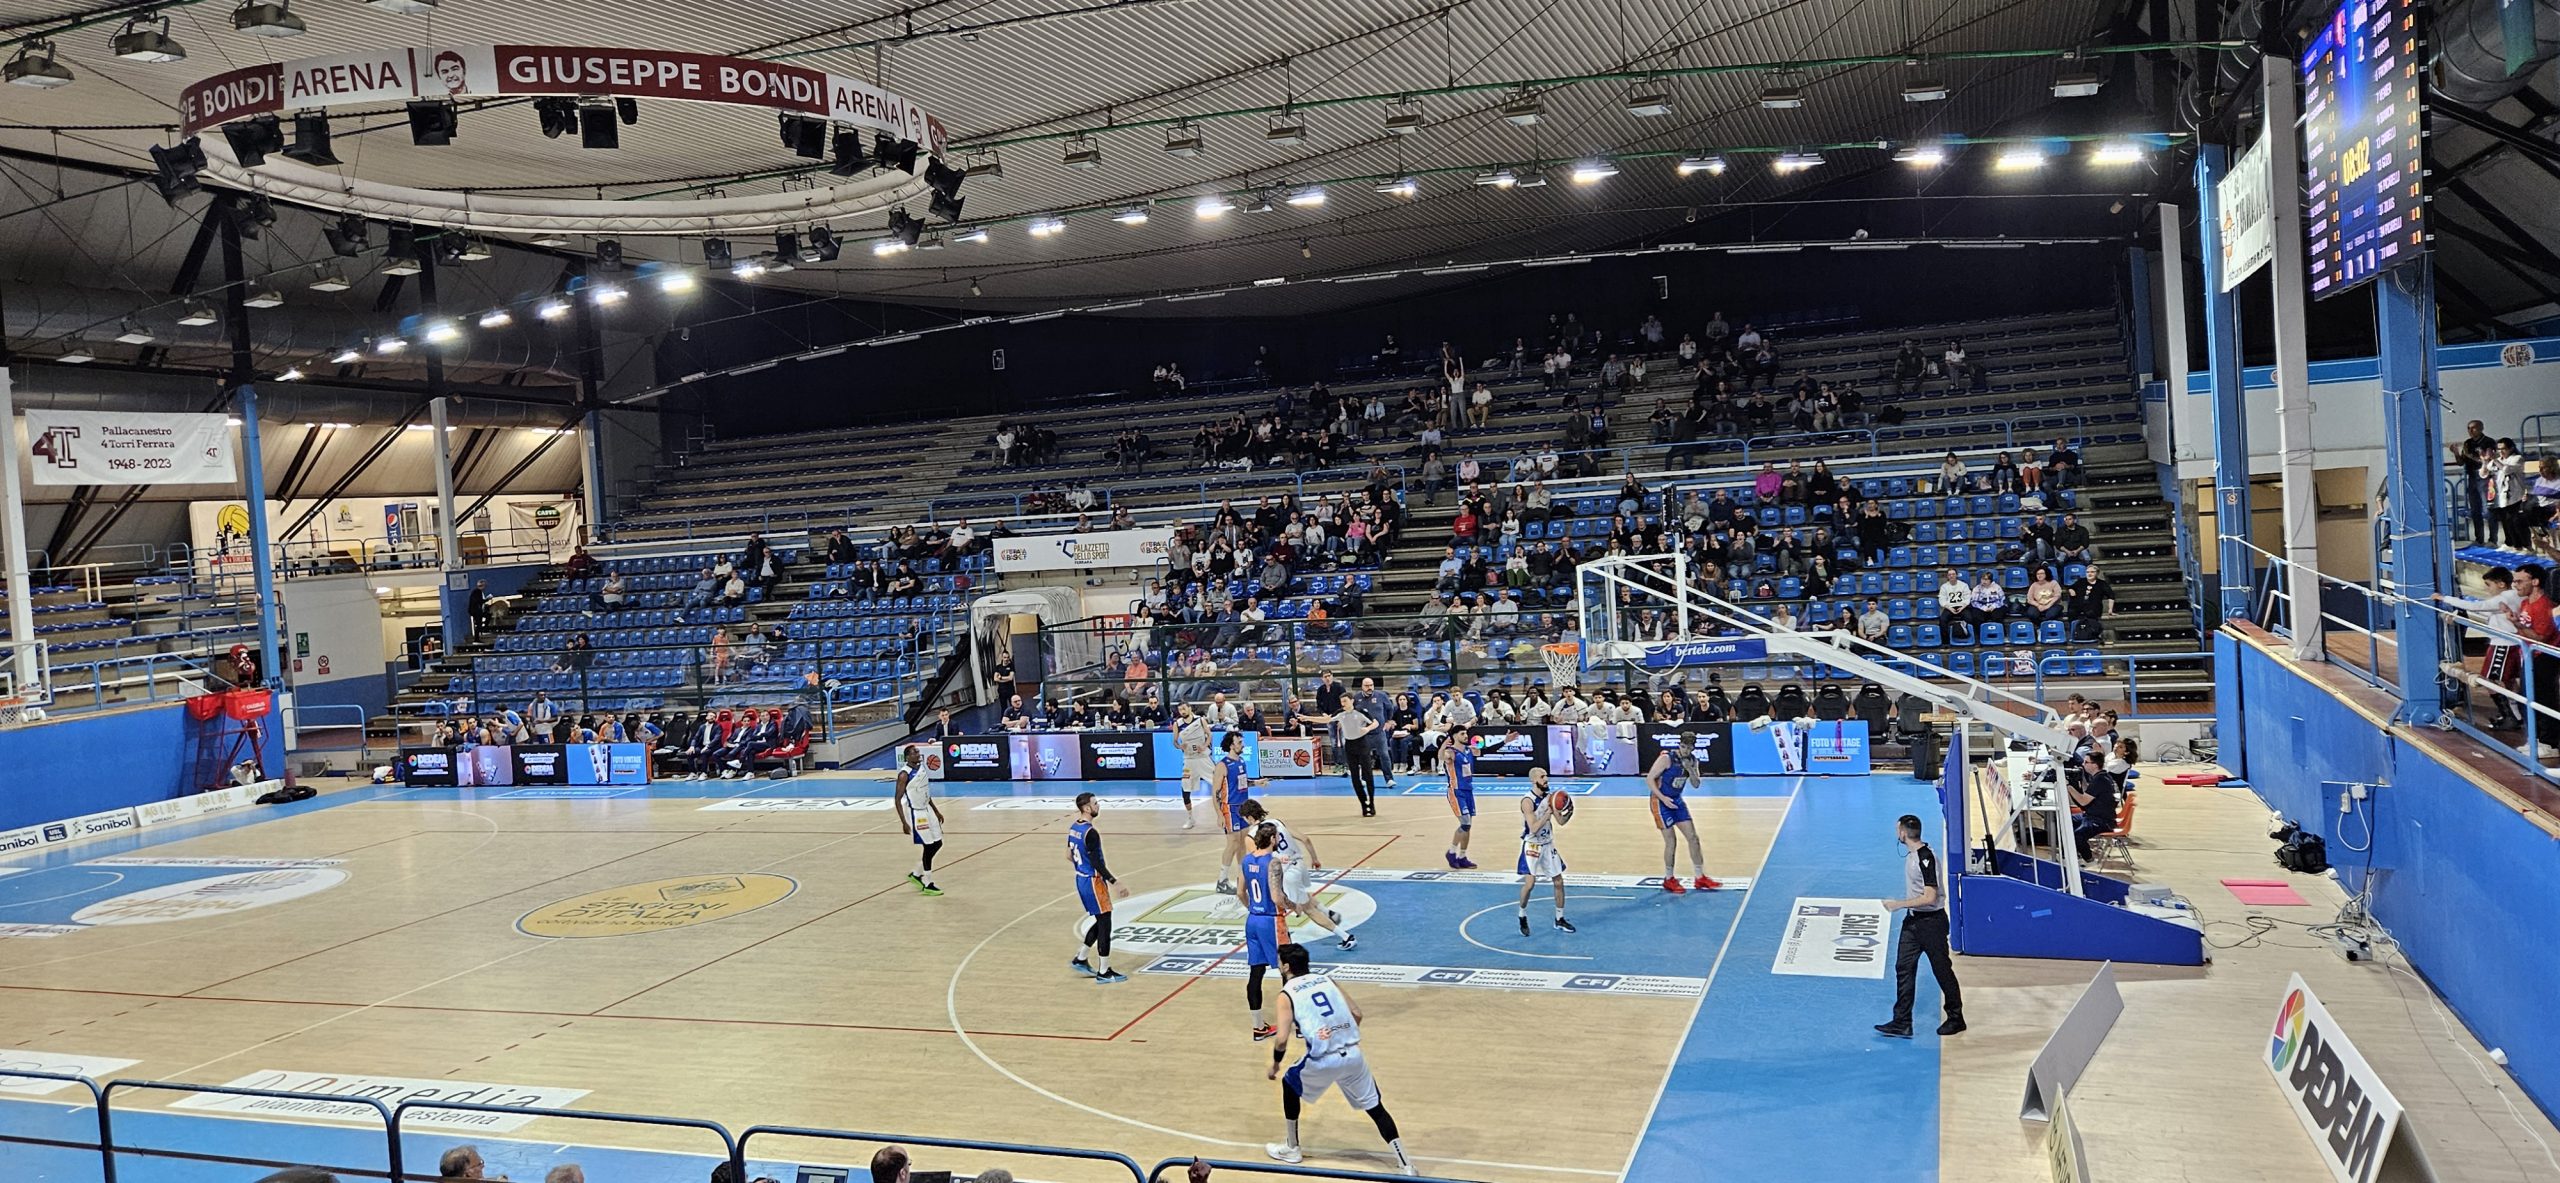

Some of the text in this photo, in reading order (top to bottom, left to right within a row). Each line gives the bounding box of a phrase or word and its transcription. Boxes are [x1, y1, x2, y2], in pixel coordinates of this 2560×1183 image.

[203, 75, 274, 118] BONDI
[292, 61, 402, 99] ARENA
[508, 55, 901, 128] GIUSEPPE BONDI ARENA
[2343, 136, 2370, 186] 08:02
[102, 426, 172, 437] Pallacanestro
[101, 439, 175, 449] 4 Torri Ferrara
[108, 459, 136, 469] 1948
[144, 458, 172, 469] 2023
[1074, 542, 1110, 553] PALAZZETTO
[1074, 552, 1110, 561] DELLO SPORT
[1675, 643, 1736, 657] bertele.com
[1811, 738, 1830, 747] FOTO
[960, 743, 998, 755] DEDEM
[417, 754, 448, 765] DEDEM
[1105, 756, 1135, 766] DEDEM
[197, 791, 232, 808] AGIRE
[143, 802, 182, 818] AGIRE
[86, 816, 132, 835] Sanibol
[1251, 879, 1262, 903] 0
[580, 901, 730, 912] STAGIONI
[555, 909, 704, 920] D'ITALIA
[1111, 934, 1246, 946] FERRAR
[1832, 913, 1880, 963] ESAGONO
[1161, 961, 1195, 970] CFI
[1429, 971, 1465, 981] CFI
[1466, 979, 1546, 987] Innovazione
[1574, 978, 1611, 987] CFI
[1620, 981, 1701, 989] Formazione
[1614, 986, 1701, 995] Innovazione
[1311, 991, 1335, 1018] 9
[290, 1076, 543, 1108] Dimedia
[2289, 1019, 2386, 1183] DEDEM
[244, 1097, 373, 1117] pianificare
[404, 1109, 501, 1126] esterna
